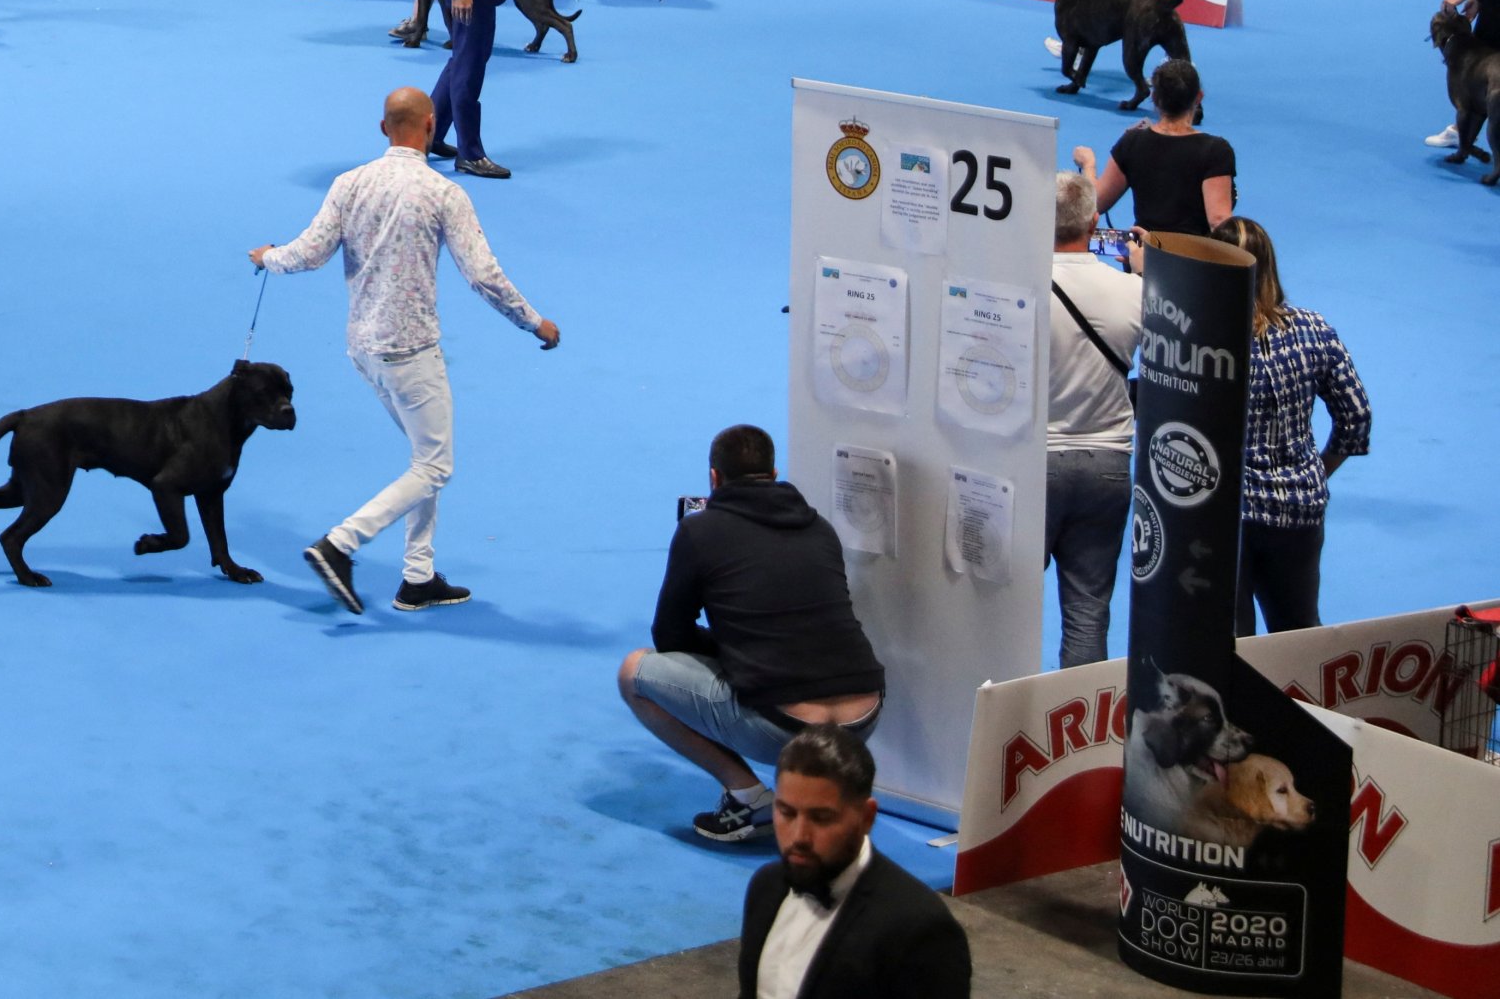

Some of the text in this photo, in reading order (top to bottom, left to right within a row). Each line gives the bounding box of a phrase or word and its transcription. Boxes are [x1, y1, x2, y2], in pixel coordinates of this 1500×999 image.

[950, 149, 1013, 221] 25
[847, 289, 876, 301] RING 25
[973, 309, 1002, 322] RING 25
[1141, 327, 1235, 380] anium
[1147, 366, 1198, 394] NUTRITION
[1153, 452, 1209, 488] INGREDIENTS
[1155, 440, 1211, 479] NATURAL
[1001, 686, 1127, 814] ARI
[1123, 811, 1245, 869] NUTRITION
[1142, 892, 1200, 921] WORLD
[1141, 907, 1200, 946] DOG
[1211, 912, 1288, 936] 2020
[1141, 930, 1199, 961] SHOW
[1210, 933, 1287, 948] MADRID
[1257, 951, 1285, 968] abril
